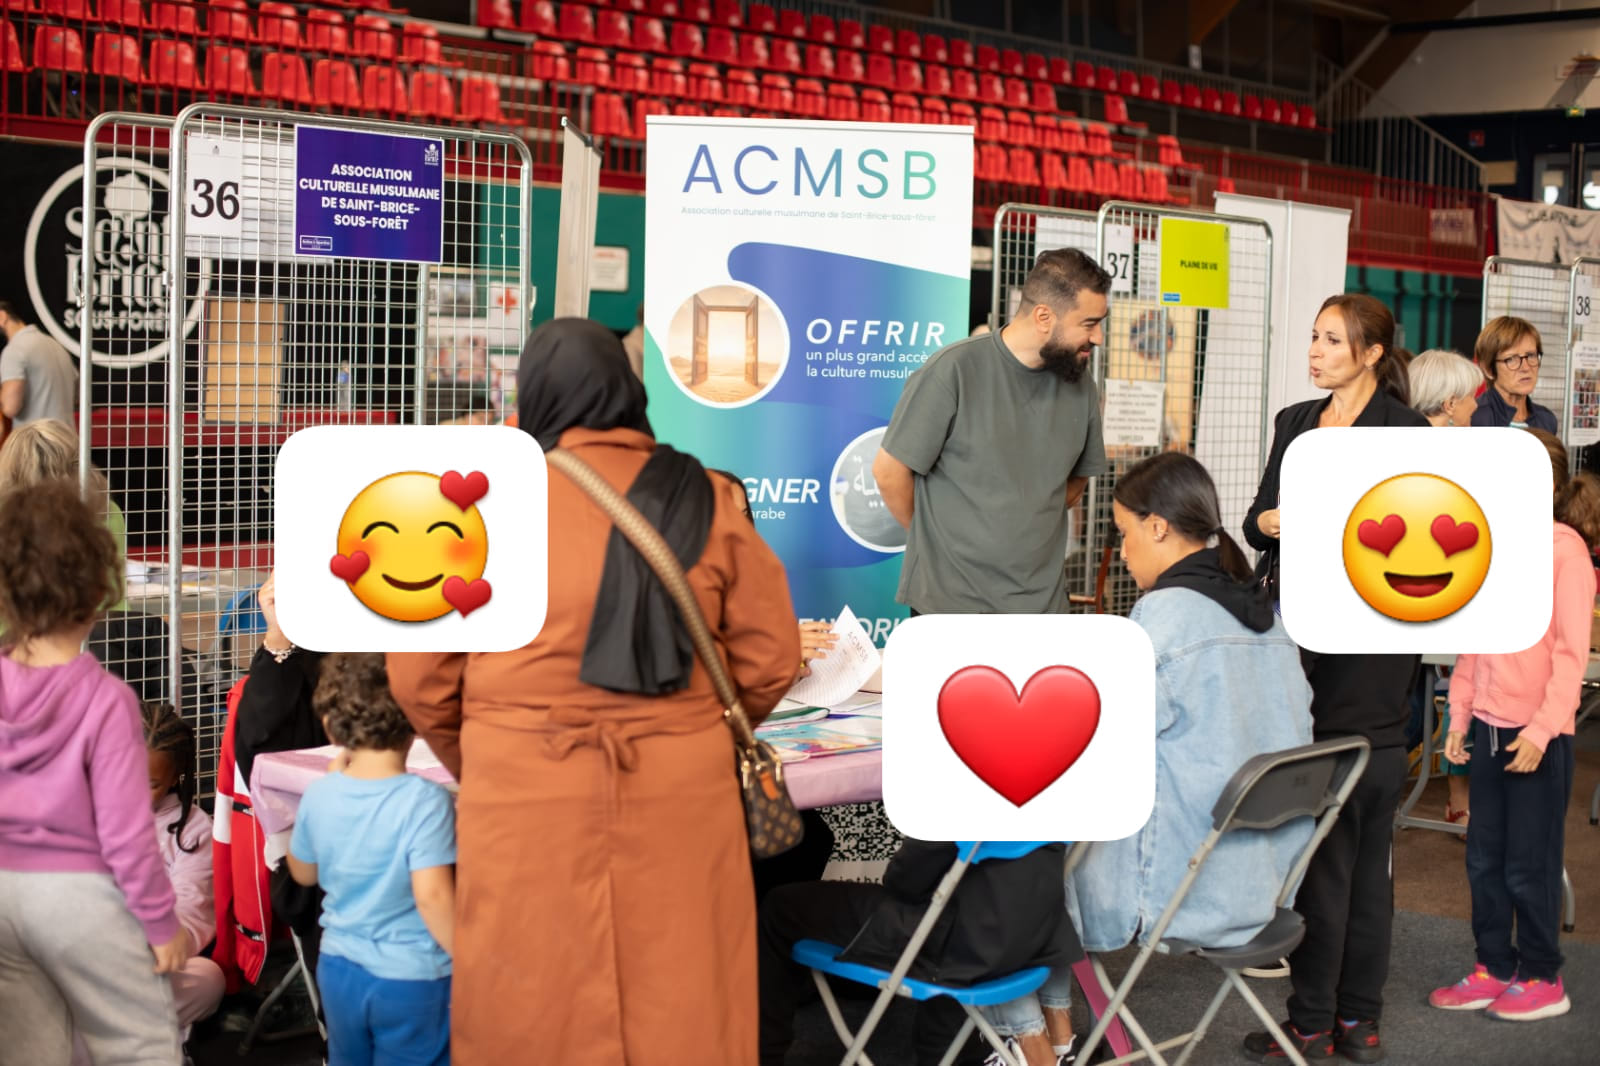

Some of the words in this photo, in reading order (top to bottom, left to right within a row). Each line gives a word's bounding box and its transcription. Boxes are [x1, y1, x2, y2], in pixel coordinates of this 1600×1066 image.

[331, 163, 412, 182] ASSOCIATION
[682, 144, 937, 200] ACMSB
[299, 178, 369, 194] CULTURELLE
[370, 183, 440, 200] MUSULMANE
[191, 179, 239, 220] 36
[321, 196, 337, 208] DE
[339, 198, 420, 214] SAINT-BRICE-
[334, 214, 409, 230] SOUS-FORÊT
[681, 206, 732, 215] Association
[733, 207, 772, 216] culturelle
[774, 208, 826, 218] musulmane
[827, 210, 838, 218] de
[1107, 252, 1130, 279] 37
[1575, 296, 1591, 316] 38
[806, 318, 945, 346] OFFRIR
[806, 351, 822, 361] un
[825, 348, 854, 364] plus
[856, 349, 895, 365] grand
[898, 351, 929, 363] accè
[807, 364, 818, 377] la
[821, 365, 866, 378] culture
[742, 477, 820, 504] GNER
